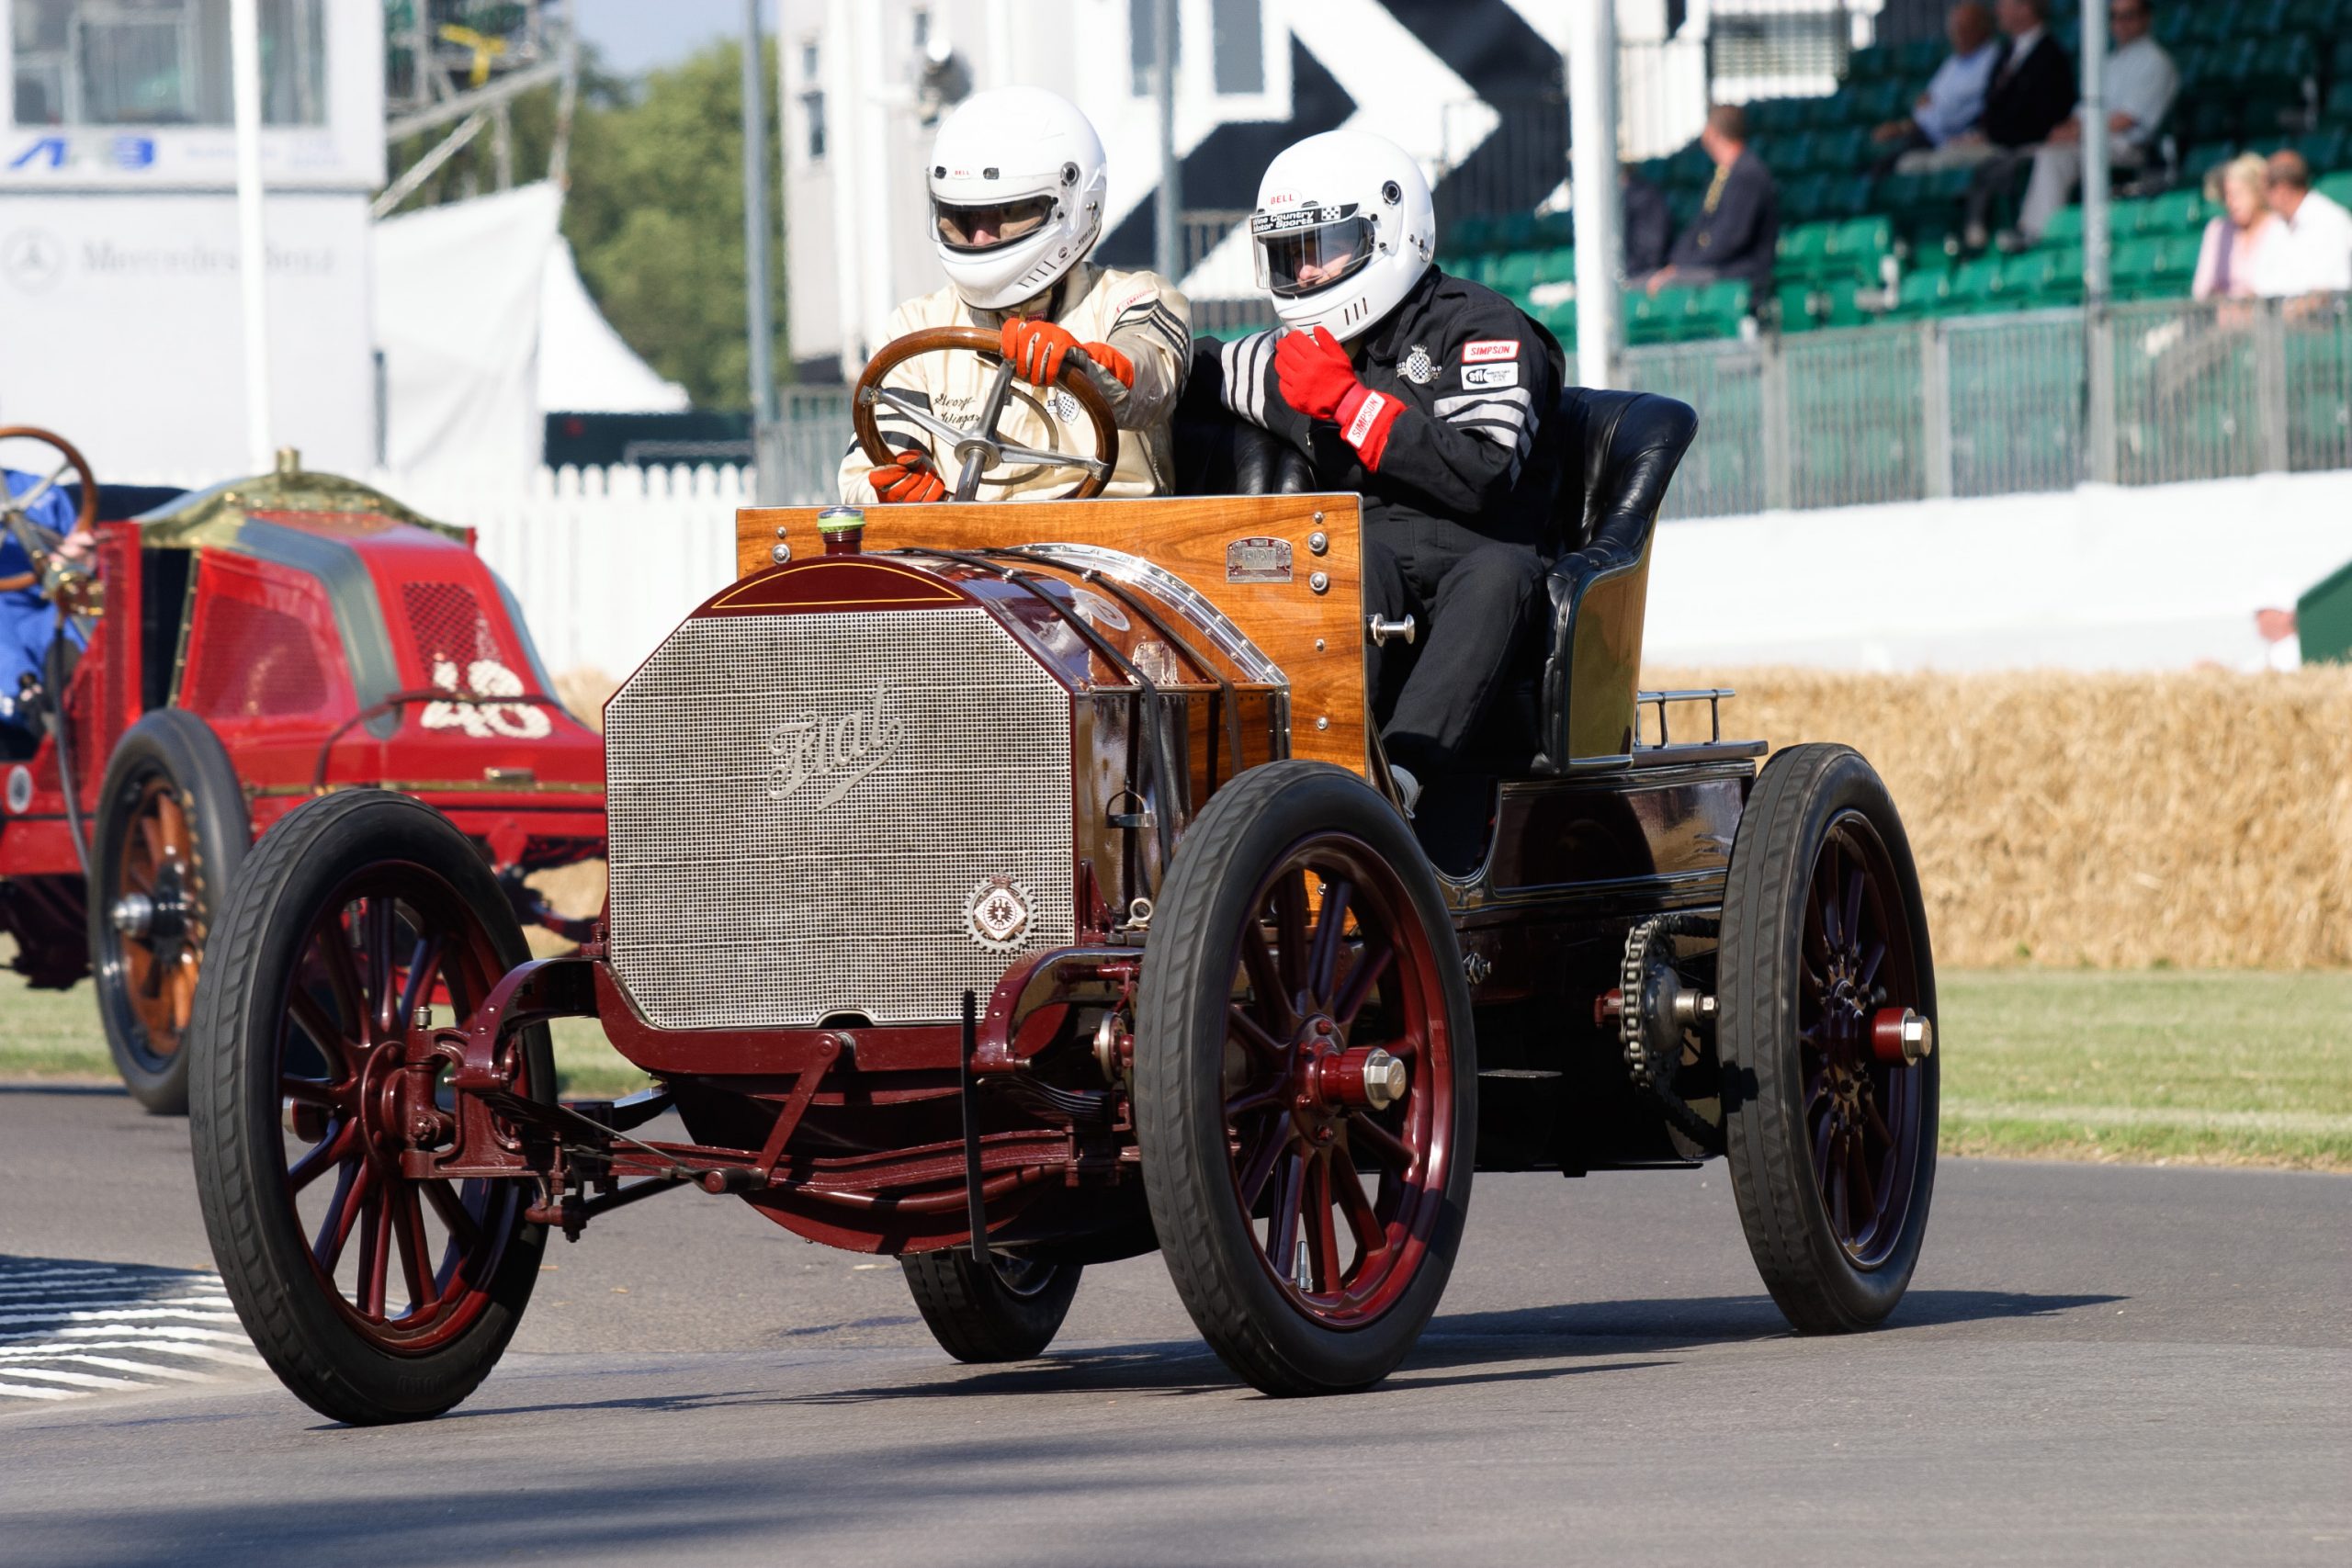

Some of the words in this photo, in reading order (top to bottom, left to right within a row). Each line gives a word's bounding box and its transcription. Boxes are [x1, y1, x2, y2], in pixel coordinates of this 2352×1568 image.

[1271, 194, 1294, 205] BELL
[1270, 210, 1314, 222] Country
[1275, 218, 1314, 231] Sports
[1470, 344, 1510, 356] SIMPSON
[1351, 398, 1379, 438] SIMPSON
[766, 680, 903, 811] Fiat
